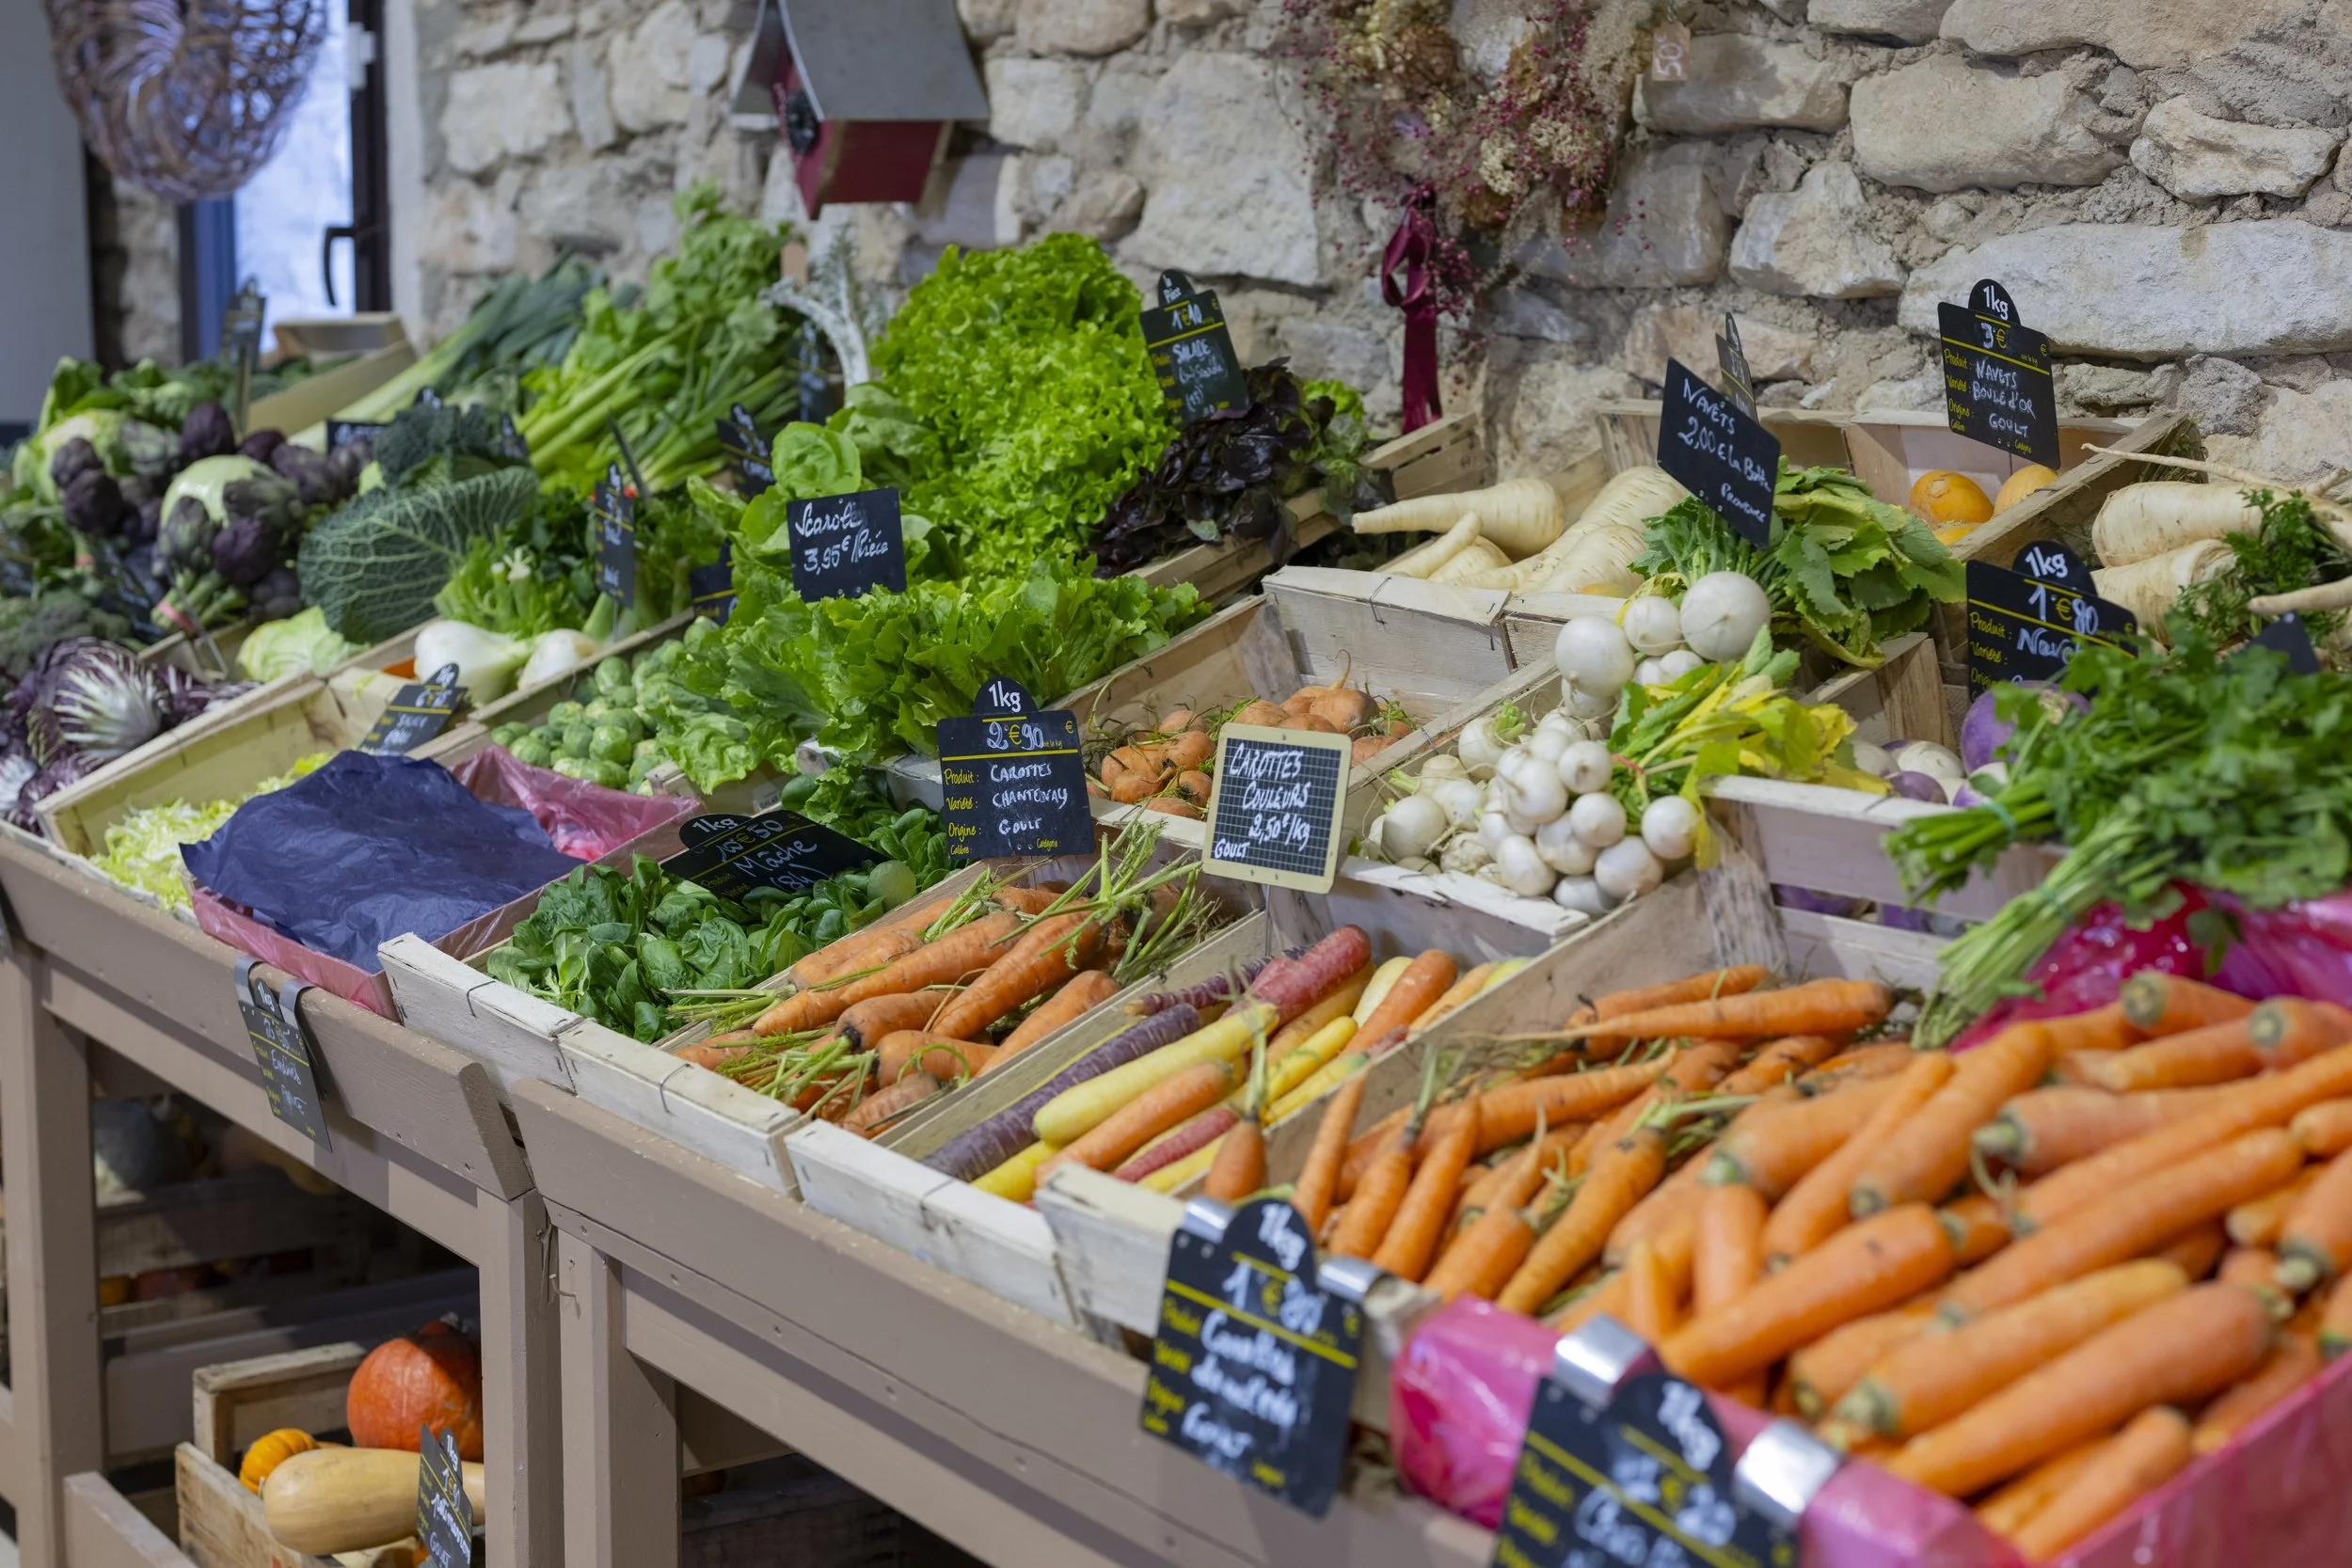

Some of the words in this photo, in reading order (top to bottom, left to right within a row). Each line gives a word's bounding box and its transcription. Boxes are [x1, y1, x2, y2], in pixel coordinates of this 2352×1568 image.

[1982, 285, 2009, 321] 1kg
[1989, 413, 2028, 438] GOULT
[2025, 546, 2069, 578] 1kg
[988, 680, 1022, 713] 1kg
[991, 762, 1053, 783] CAROTTES
[1229, 742, 1305, 781] CAROTTES
[1242, 781, 1312, 811] COULEURS
[691, 816, 739, 833] 1kg
[1214, 838, 1250, 859] GOULT
